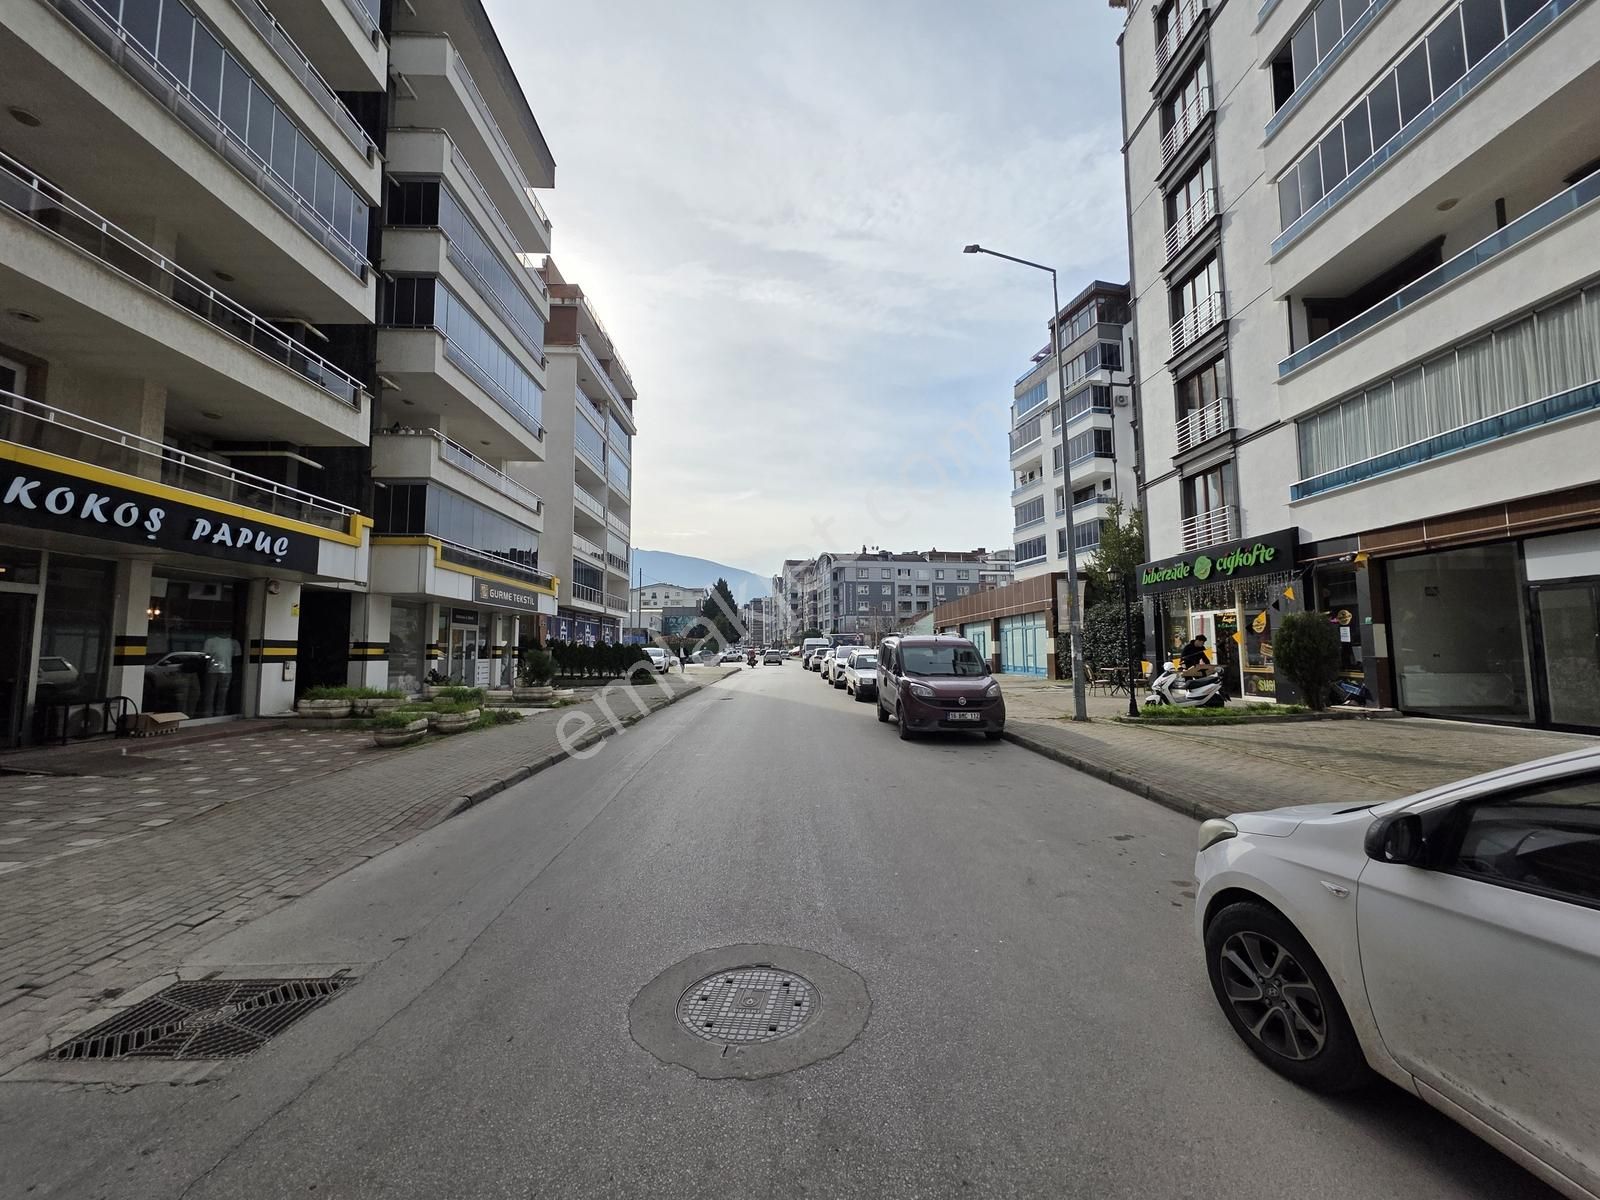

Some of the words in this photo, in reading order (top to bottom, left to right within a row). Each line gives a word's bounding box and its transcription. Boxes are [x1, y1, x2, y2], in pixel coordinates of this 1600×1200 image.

[4, 476, 165, 540] KOKOŞ
[192, 518, 288, 562] PAPUÇ
[1142, 561, 1190, 585] biberzade
[490, 589, 512, 601] GURME
